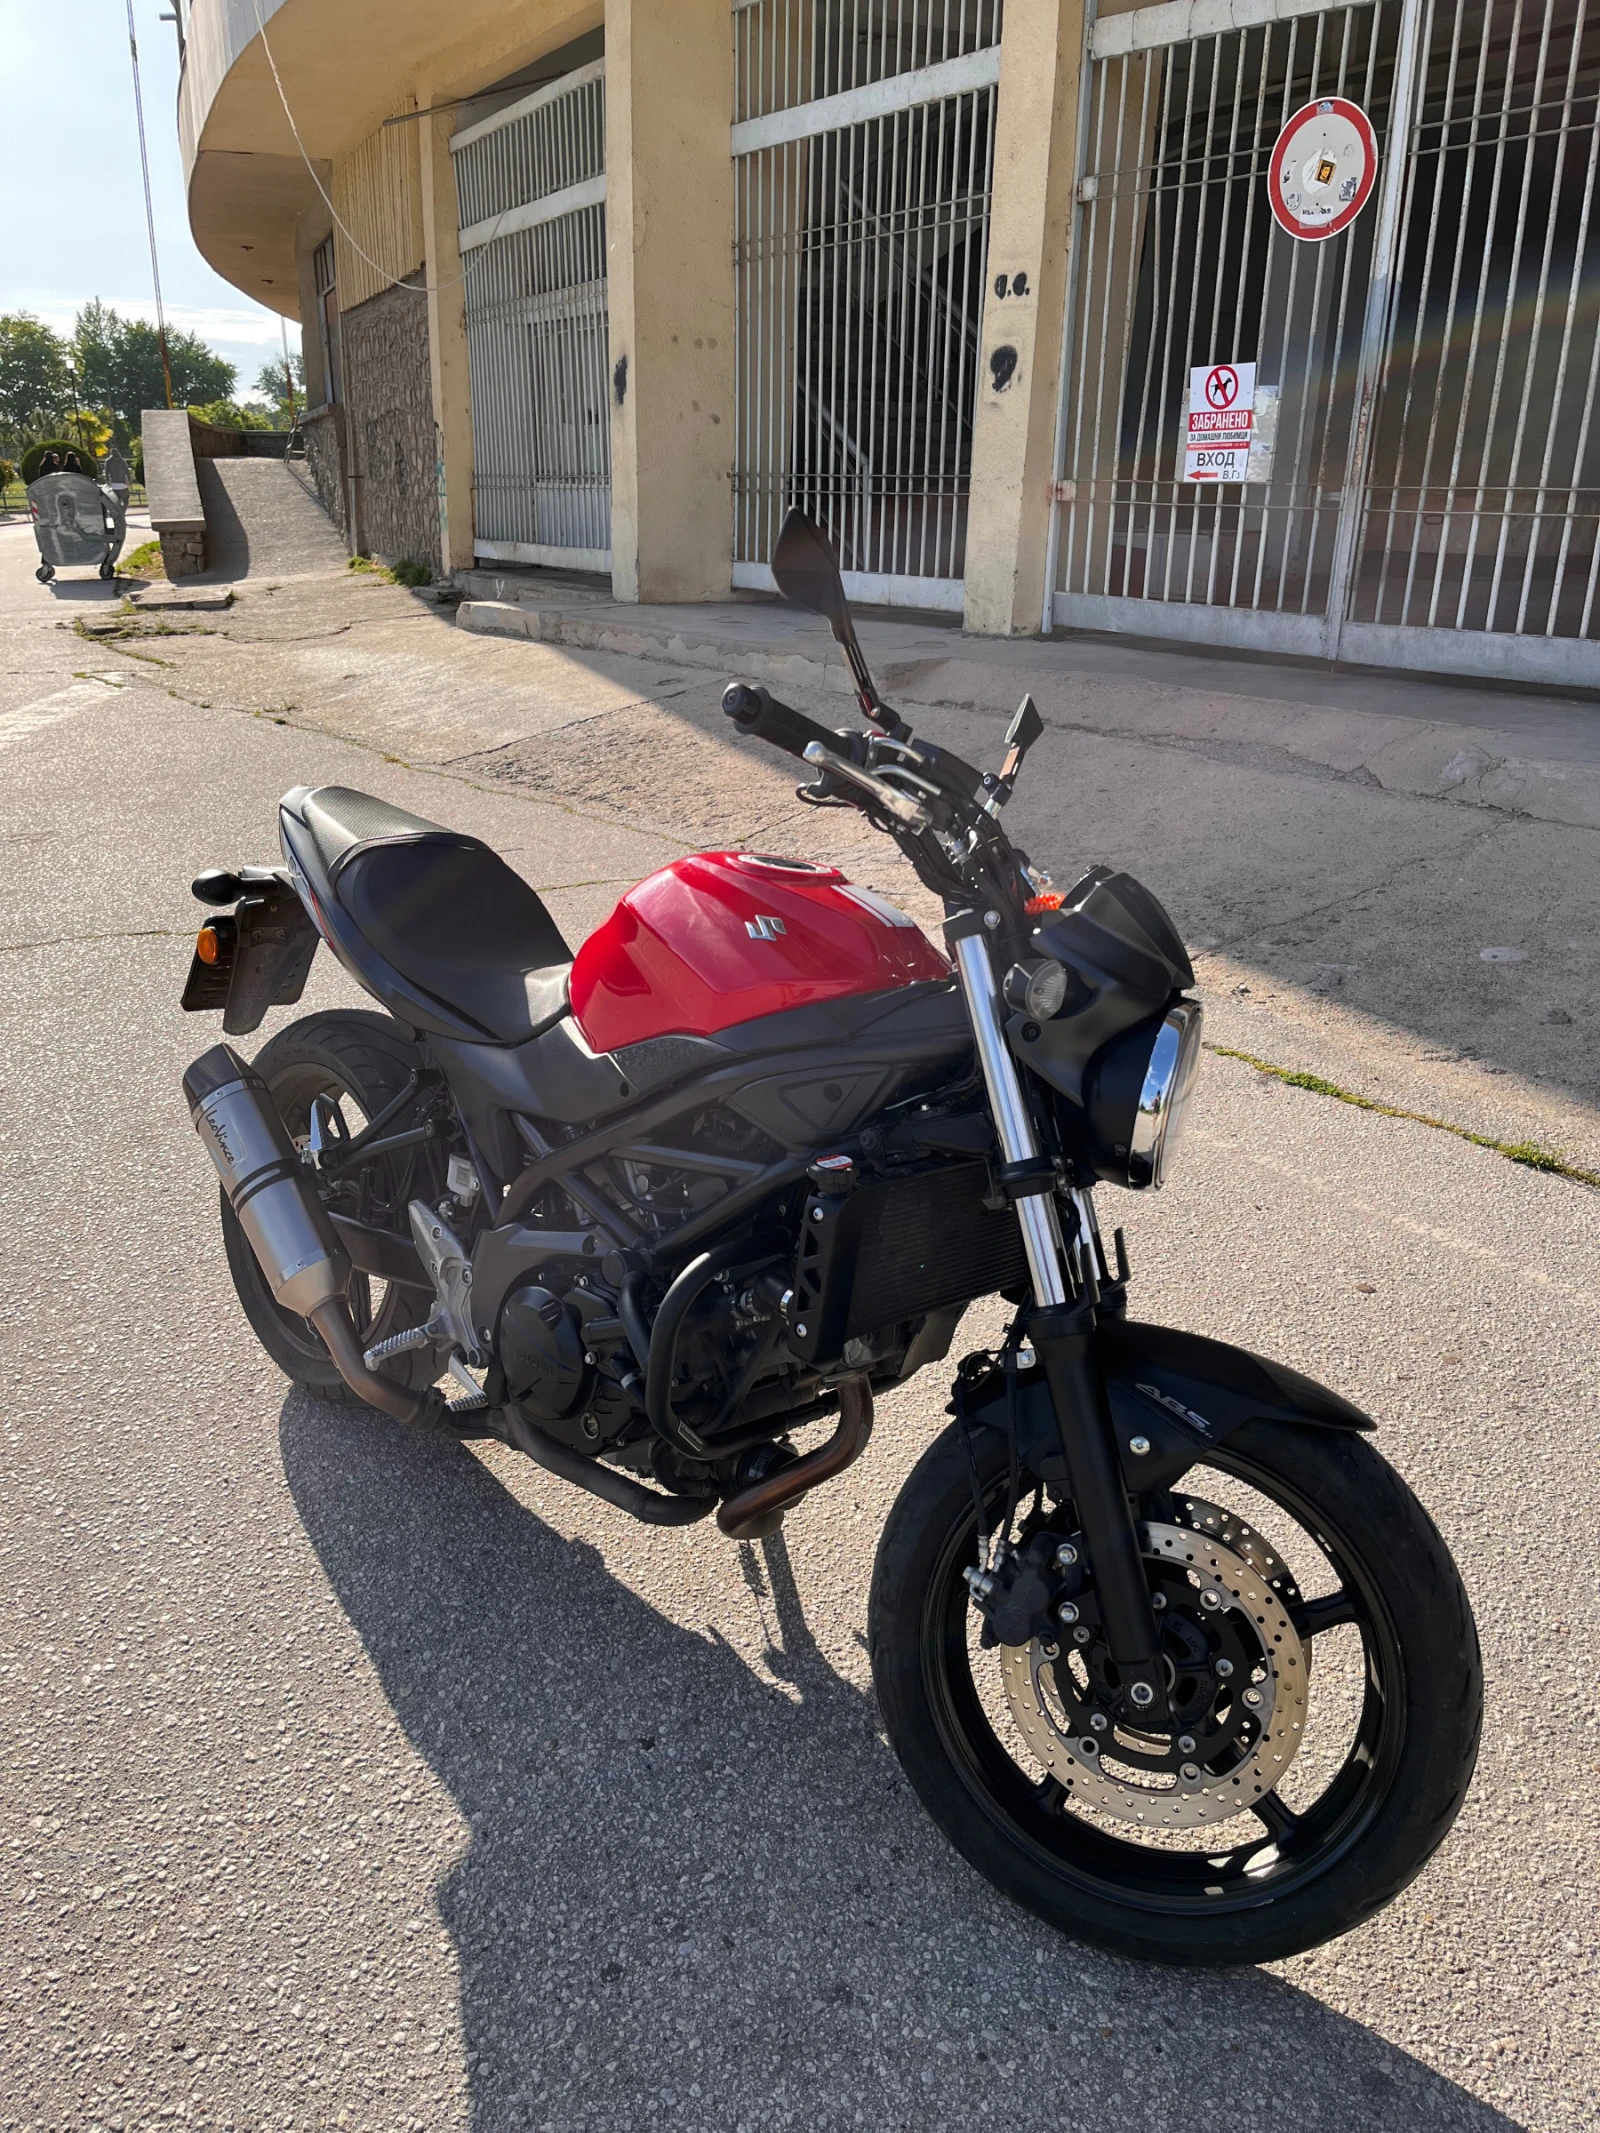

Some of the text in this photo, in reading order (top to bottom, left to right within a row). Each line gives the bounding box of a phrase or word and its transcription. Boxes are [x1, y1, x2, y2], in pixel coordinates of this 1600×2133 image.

[1191, 412, 1248, 430] ЗАБРАНЕНО
[1190, 431, 1248, 441] ЗА ДОМАШНИ ЛЮБИМЦИ
[1197, 452, 1235, 468] ВХОД
[205, 1110, 235, 1164] LeoVince
[1134, 1383, 1212, 1429] ABS
